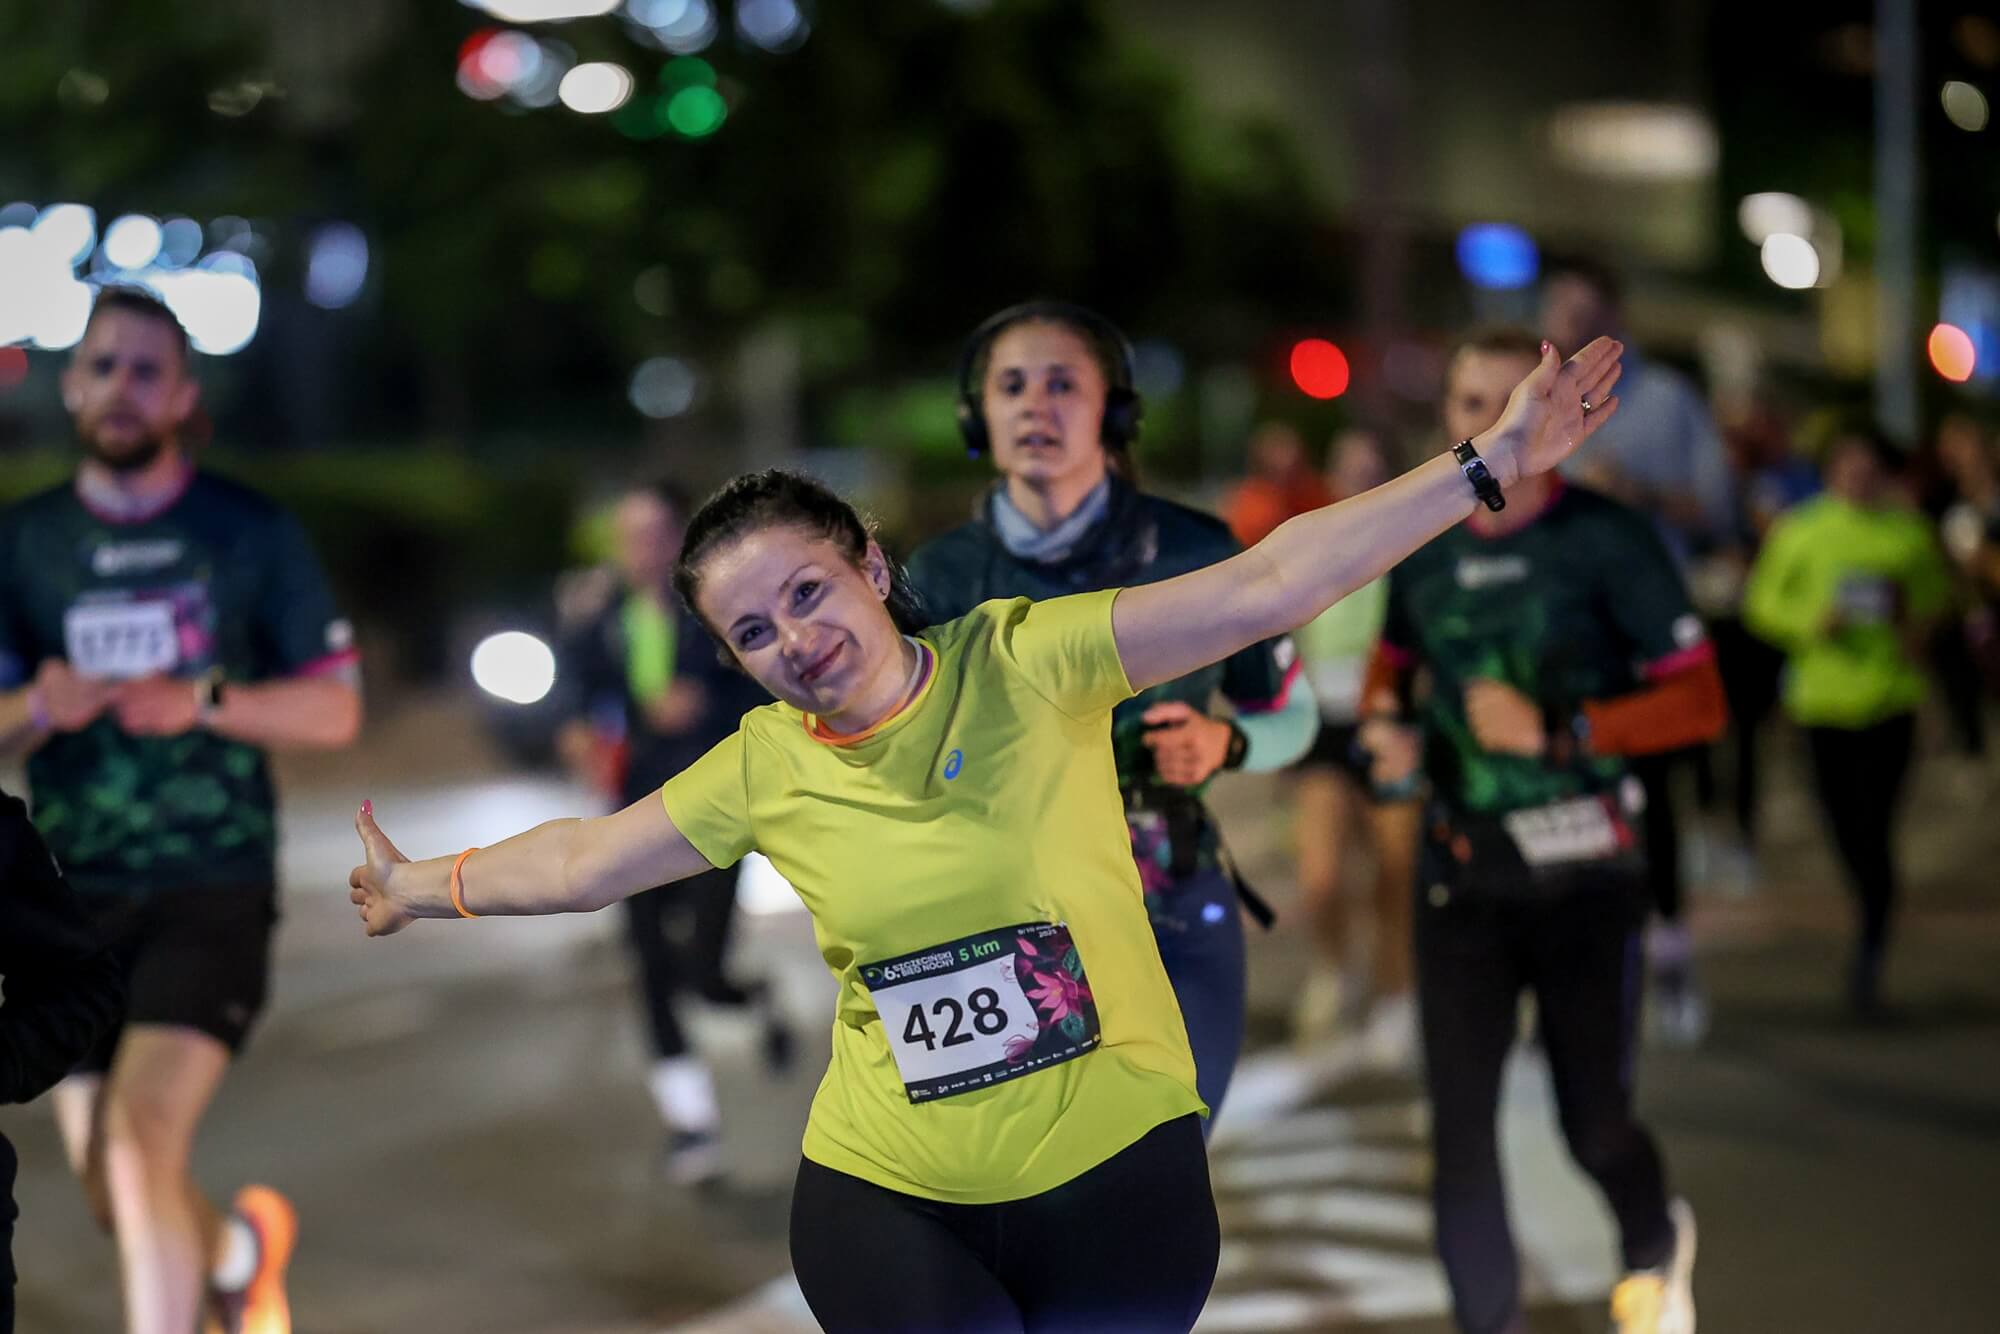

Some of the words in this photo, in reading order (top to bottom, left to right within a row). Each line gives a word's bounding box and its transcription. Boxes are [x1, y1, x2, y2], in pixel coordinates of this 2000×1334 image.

[959, 948, 970, 961] 5
[972, 940, 1001, 958] km
[884, 966, 901, 981] 6.
[922, 958, 955, 972] NOCNY
[903, 987, 1008, 1051] 428
